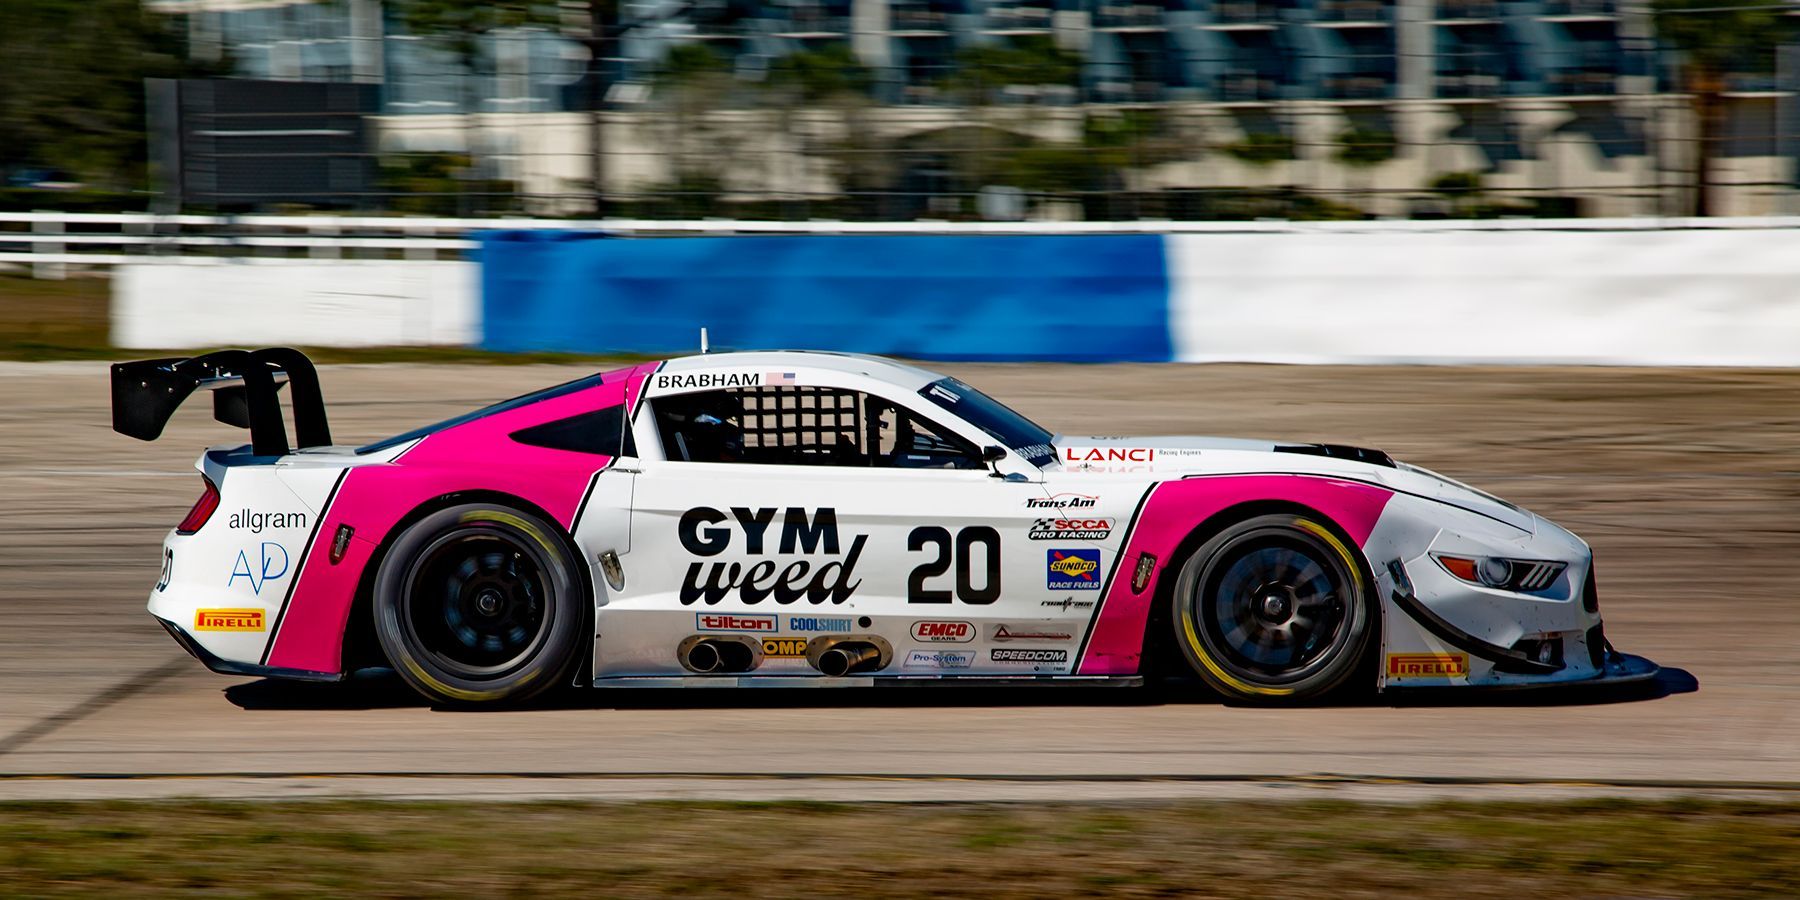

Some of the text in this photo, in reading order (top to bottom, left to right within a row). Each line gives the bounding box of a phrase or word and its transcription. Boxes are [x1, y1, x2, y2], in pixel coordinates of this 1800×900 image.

[658, 373, 759, 388] BRABHAM
[1067, 448, 1153, 461] LANCI
[1026, 497, 1096, 508] Trans Am
[229, 509, 306, 533] allgram
[1055, 520, 1110, 529] SCCA
[678, 506, 840, 557] GYM
[1030, 531, 1108, 539] PRO RACING
[679, 534, 869, 606] weed
[907, 525, 1001, 605] 20
[1052, 562, 1095, 571] SUNOCO
[198, 612, 261, 627] PIRELLI
[701, 616, 772, 629] tilton
[790, 617, 853, 632] COOLSHIRT
[918, 623, 968, 636] EMCO
[763, 641, 807, 654] OMP
[913, 654, 966, 663] Pro-System
[1390, 656, 1463, 673] PIRELLI
